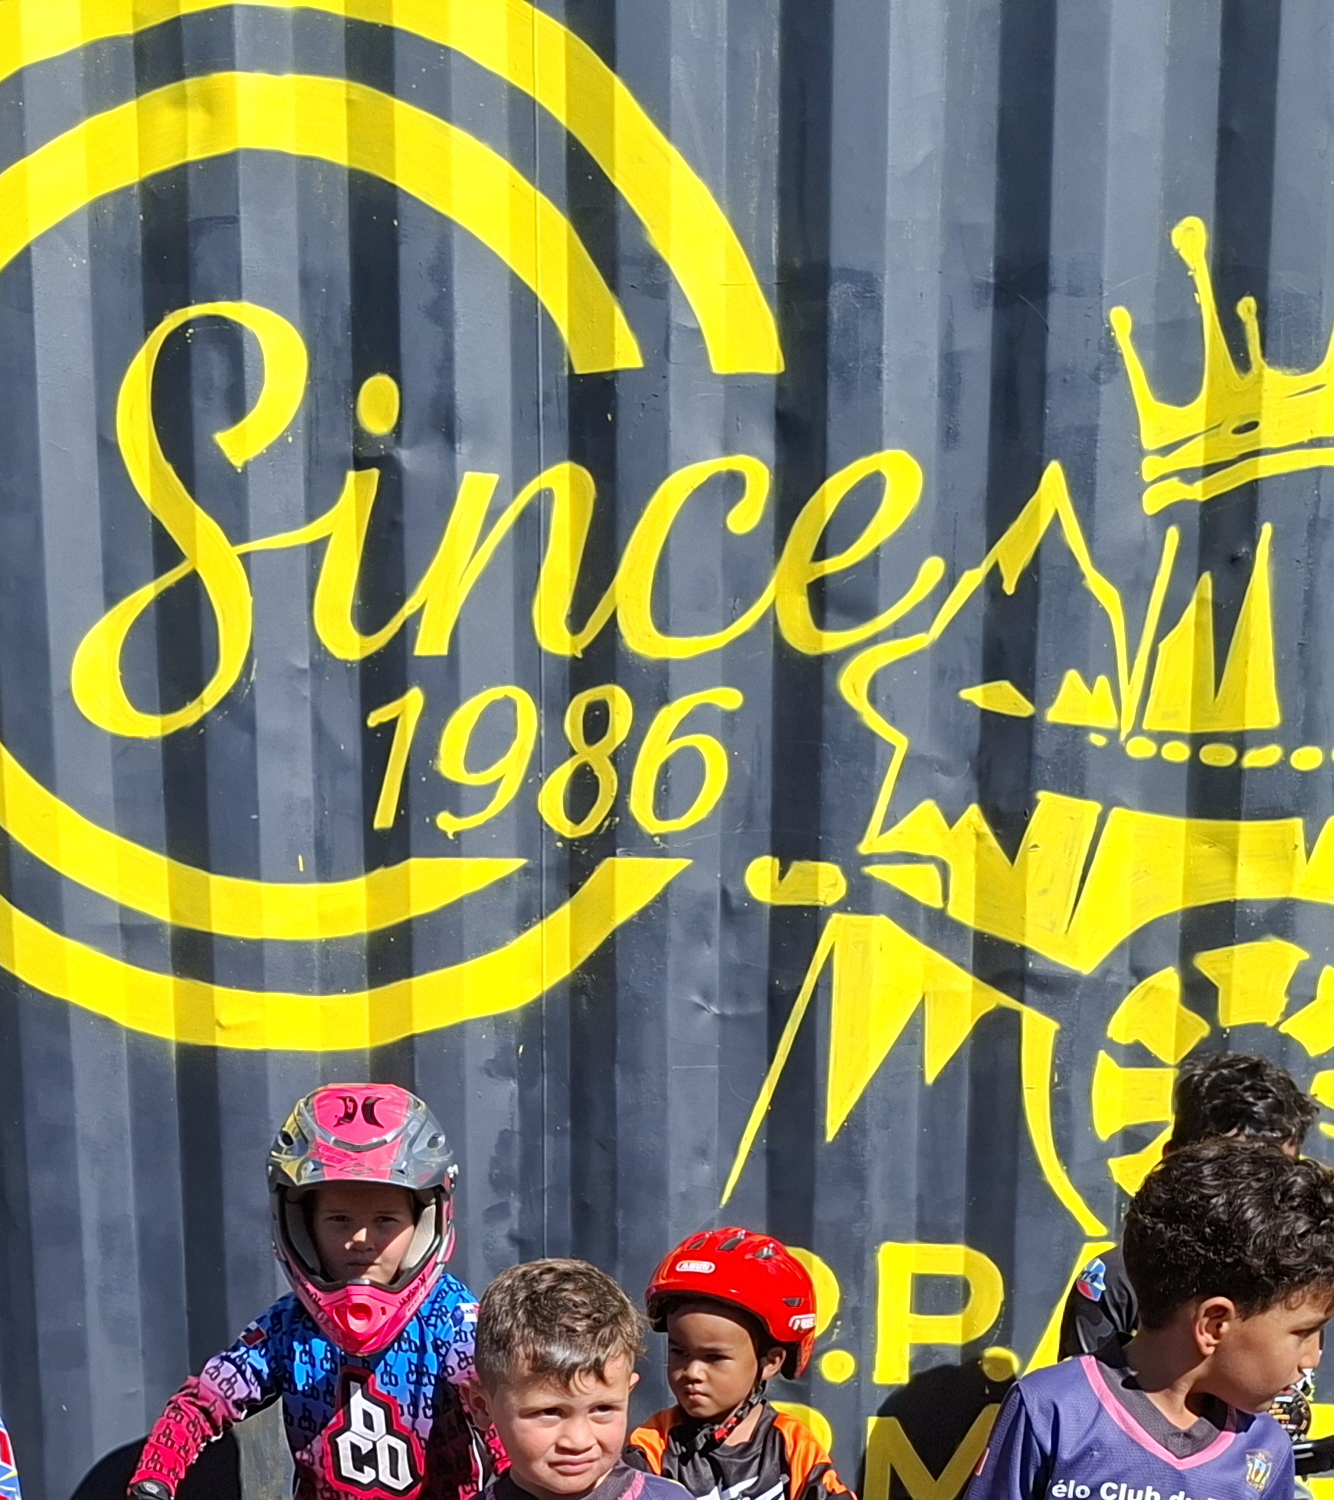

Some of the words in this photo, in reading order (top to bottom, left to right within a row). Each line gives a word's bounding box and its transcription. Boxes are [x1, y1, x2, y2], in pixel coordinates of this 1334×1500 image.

[71, 300, 946, 739] Since
[366, 683, 745, 841] 1986
[1047, 1479, 1091, 1499] élo
